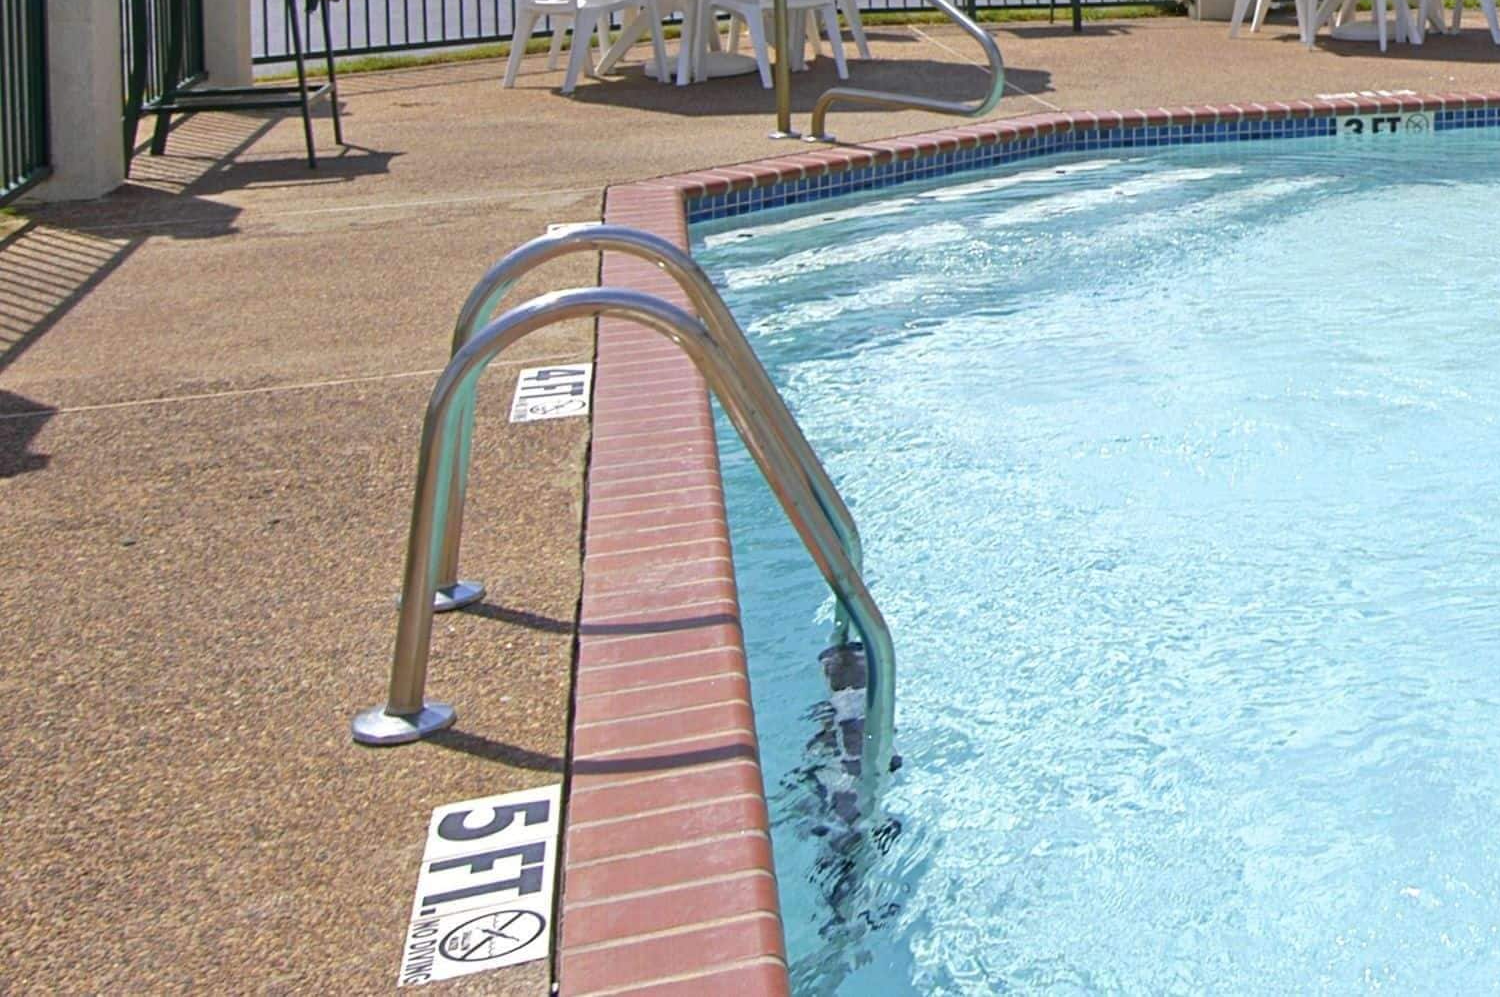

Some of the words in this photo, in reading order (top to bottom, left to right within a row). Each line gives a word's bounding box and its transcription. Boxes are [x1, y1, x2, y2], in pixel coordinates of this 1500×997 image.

[1343, 117, 1364, 134] 3
[1371, 116, 1402, 134] FT
[523, 368, 586, 381] 4
[437, 799, 551, 842] 5
[420, 840, 547, 917] FT.
[412, 918, 441, 939] NO
[403, 938, 437, 986] DIVING
